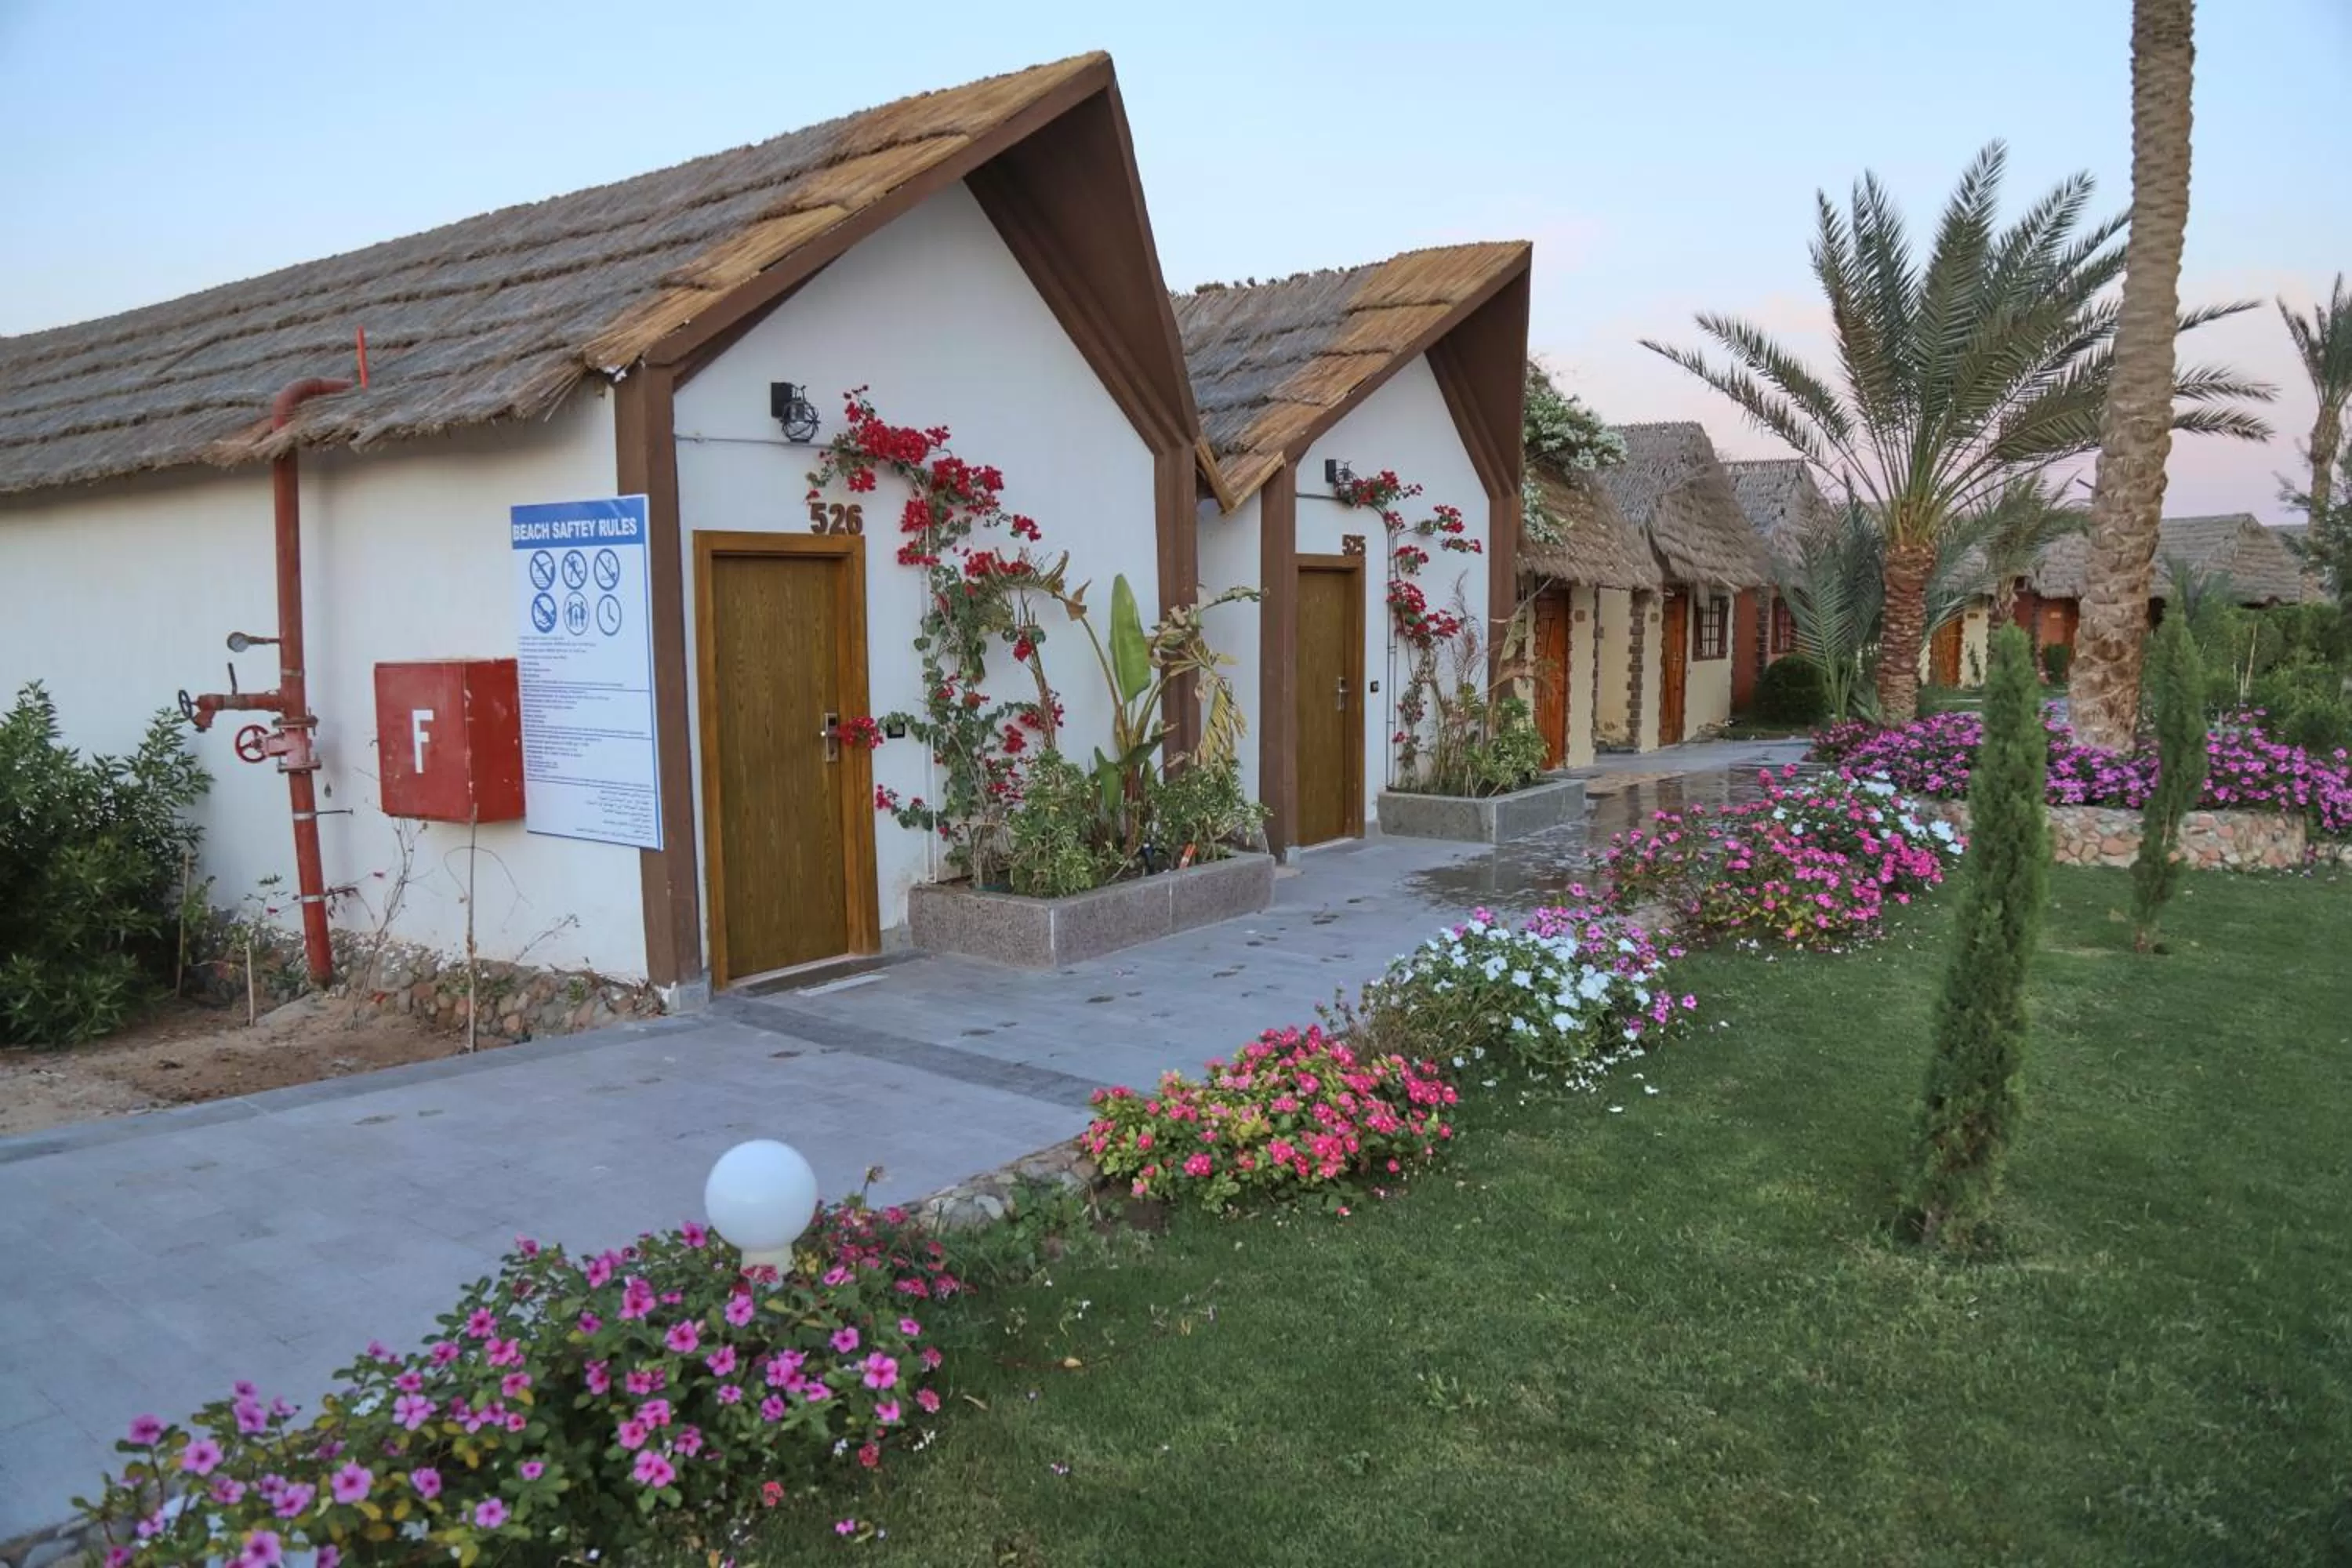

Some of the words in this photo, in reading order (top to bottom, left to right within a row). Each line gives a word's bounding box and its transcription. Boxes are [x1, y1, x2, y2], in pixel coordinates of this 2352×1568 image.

[513, 521, 550, 541] BEACH
[552, 518, 596, 539] SAFTEY
[598, 517, 637, 536] RULES
[810, 503, 863, 535] 526
[412, 709, 434, 774] F
